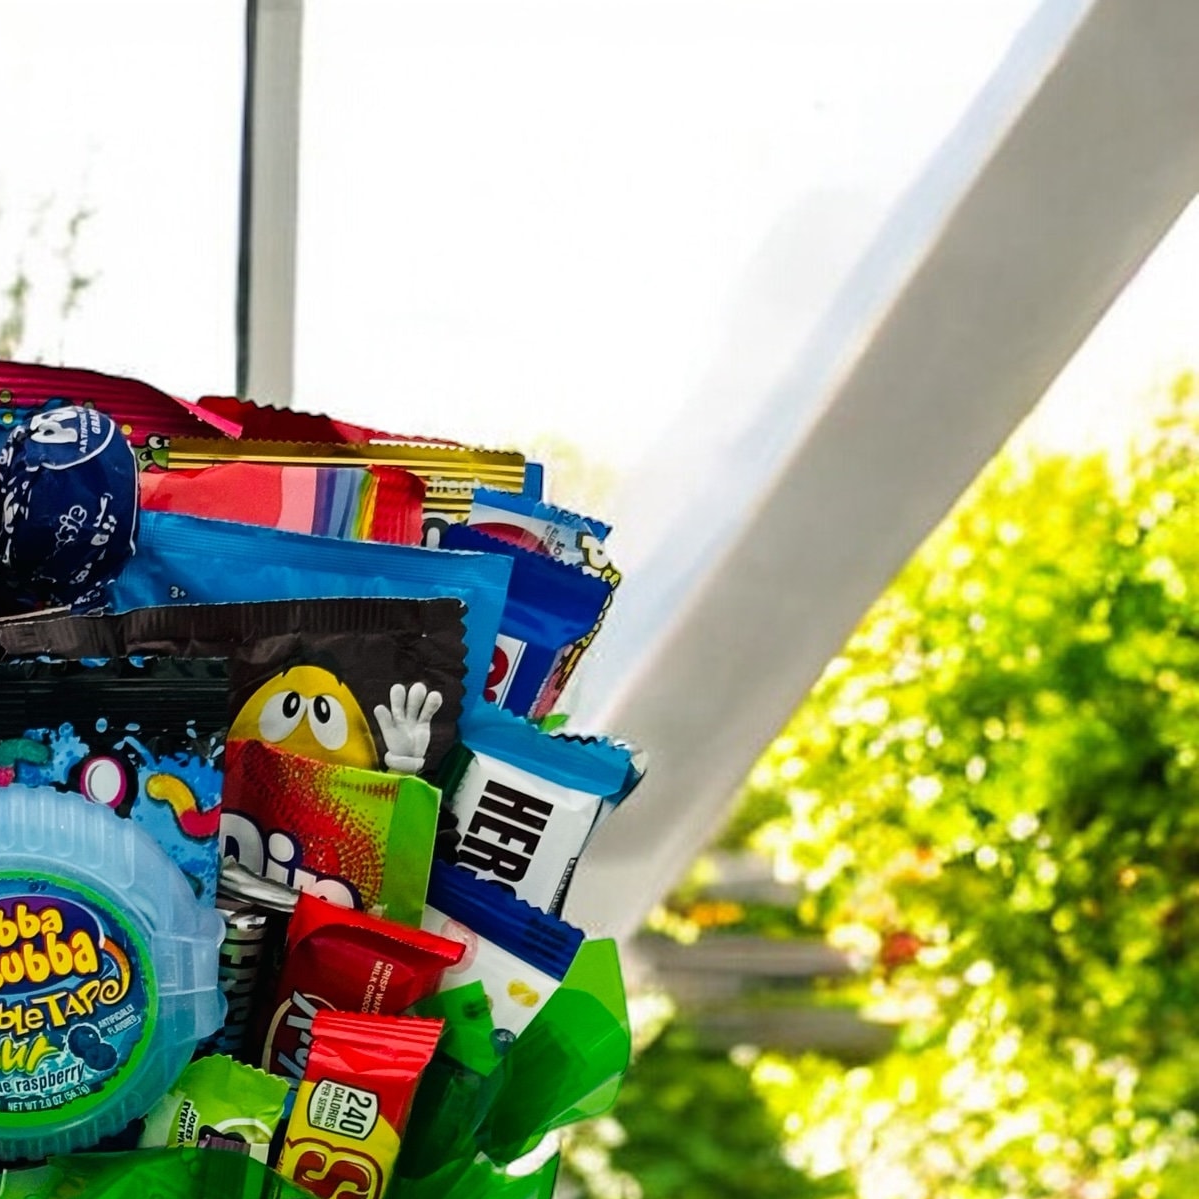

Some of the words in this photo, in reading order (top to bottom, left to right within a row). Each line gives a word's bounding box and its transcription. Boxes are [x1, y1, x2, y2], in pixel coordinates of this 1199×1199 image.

[379, 963, 393, 991] CRISP
[361, 984, 375, 1013] CHOCO
[371, 993, 384, 1015] WAF
[16, 1062, 85, 1093] raspberry
[319, 1083, 332, 1097] PER
[8, 1103, 23, 1111] NET
[25, 1102, 37, 1111] WT
[179, 1101, 191, 1131] EVERY
[324, 1086, 346, 1130] CALORIES
[338, 1090, 372, 1136] 240
[186, 1111, 198, 1141] JOKES
